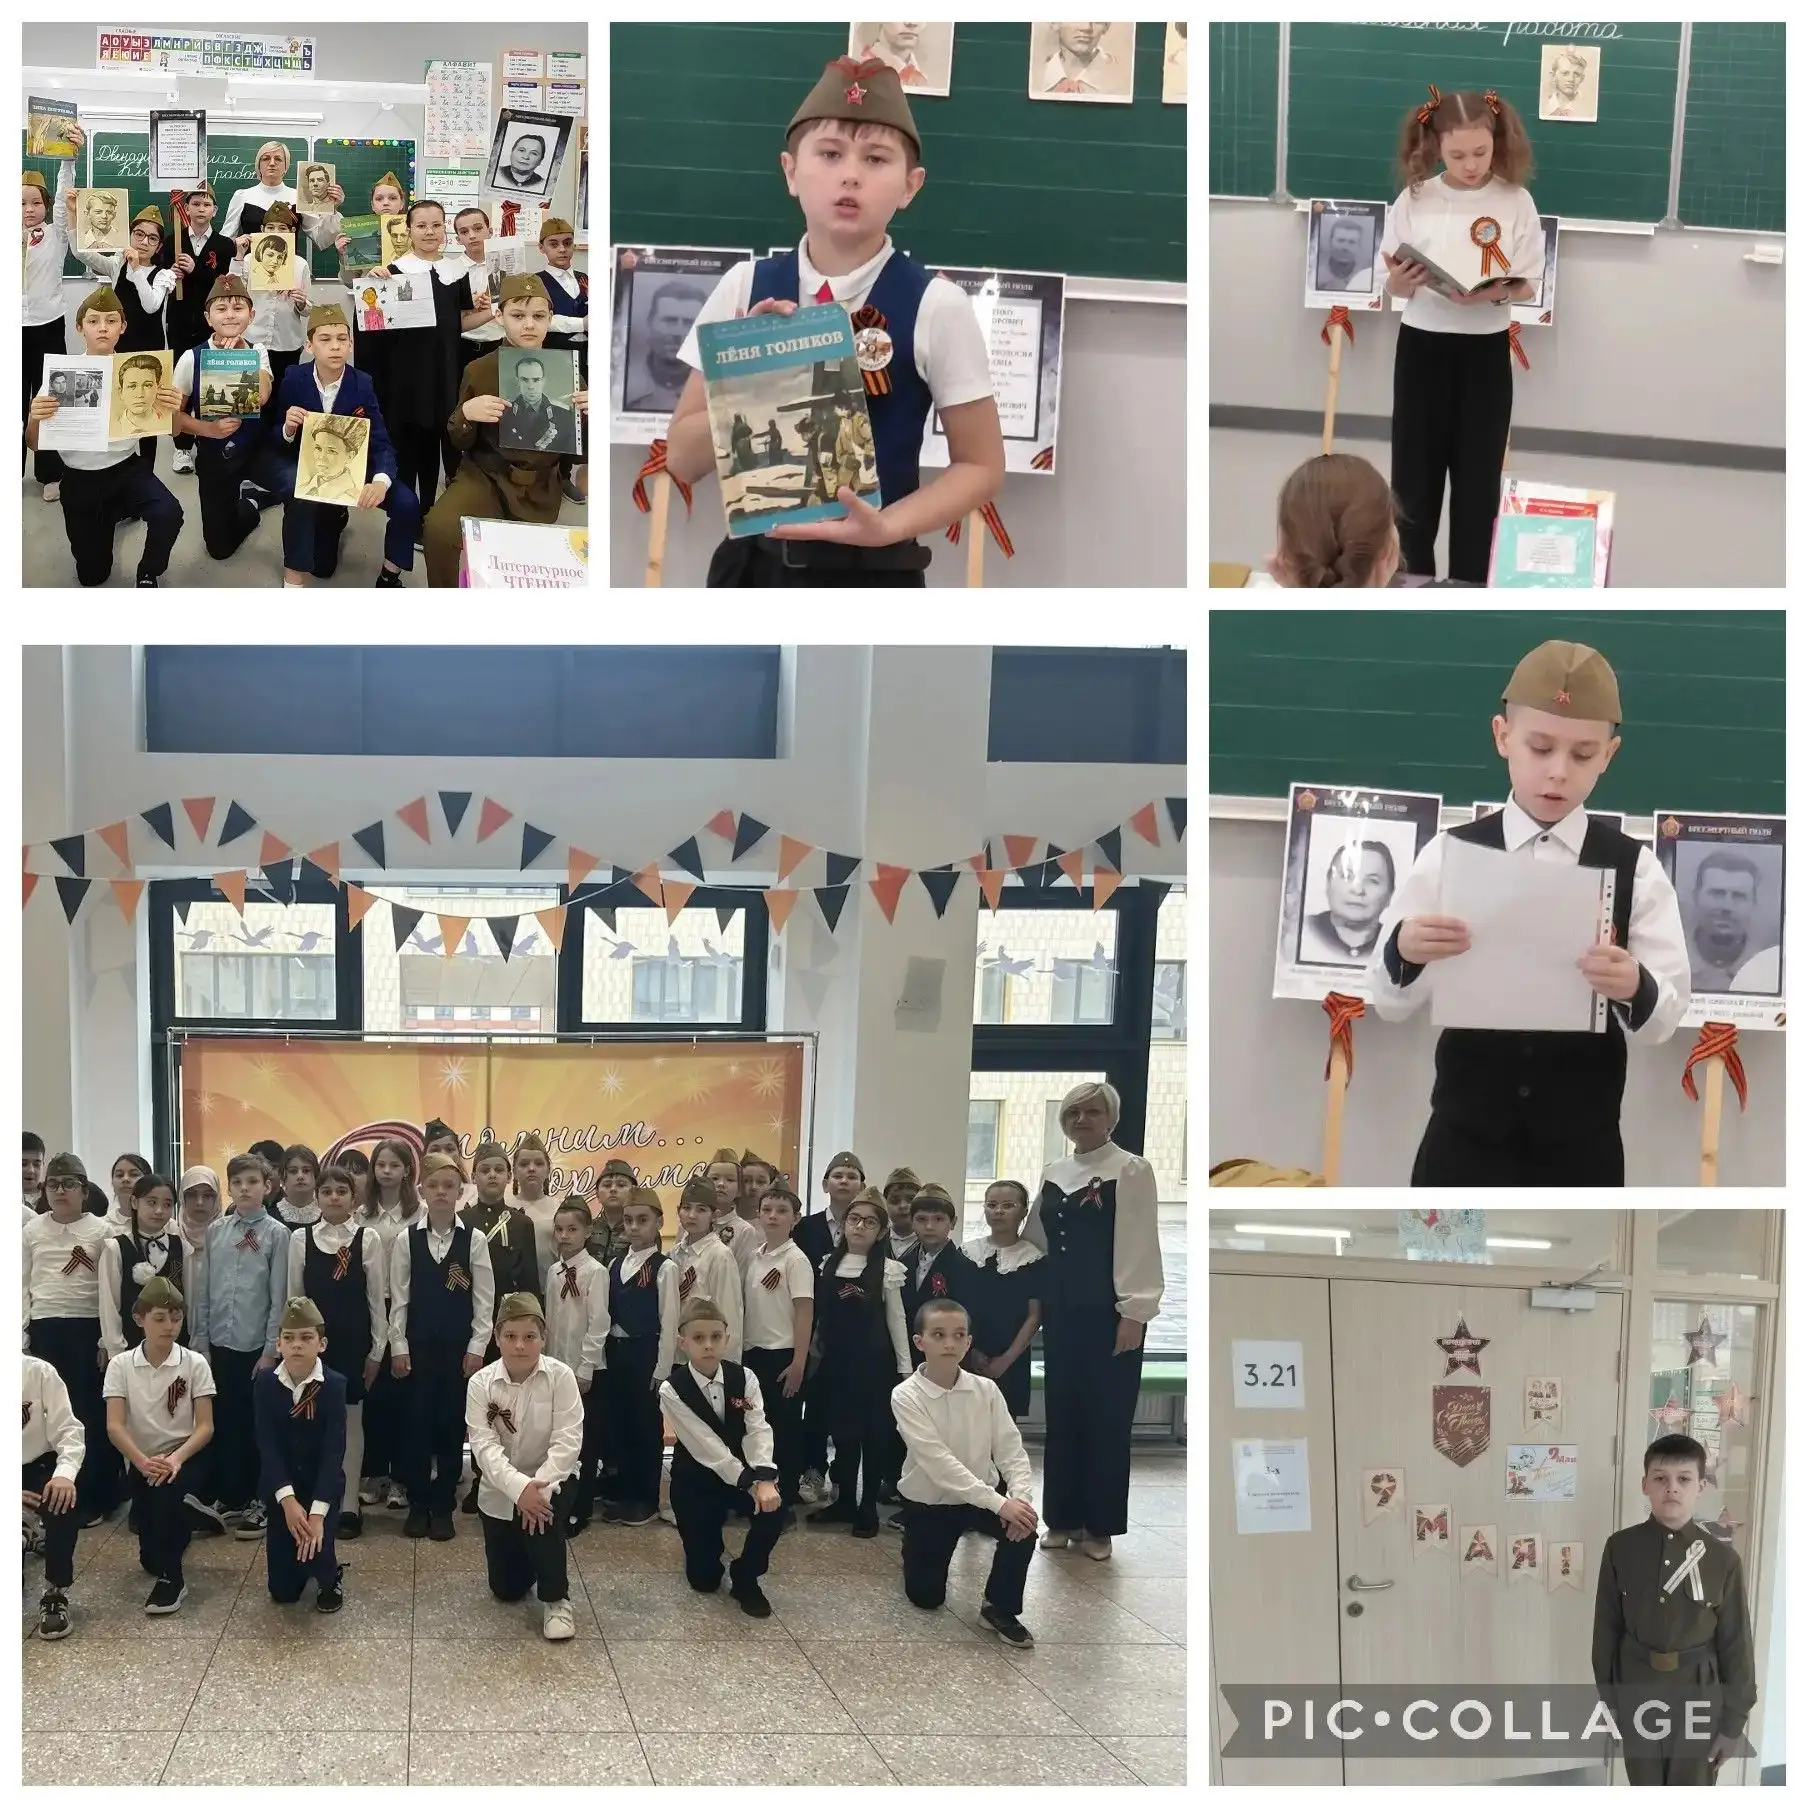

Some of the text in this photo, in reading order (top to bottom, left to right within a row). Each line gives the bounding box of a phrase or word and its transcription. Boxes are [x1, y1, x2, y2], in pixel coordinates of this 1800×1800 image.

[716, 345, 761, 365] ЛЁНЯ
[766, 330, 844, 355] ГОЛИКОВ
[488, 554, 584, 579] Литературное
[1244, 1363, 1296, 1387] 3.21
[1548, 1447, 1559, 1460] 9
[1370, 1472, 1397, 1507] 9
